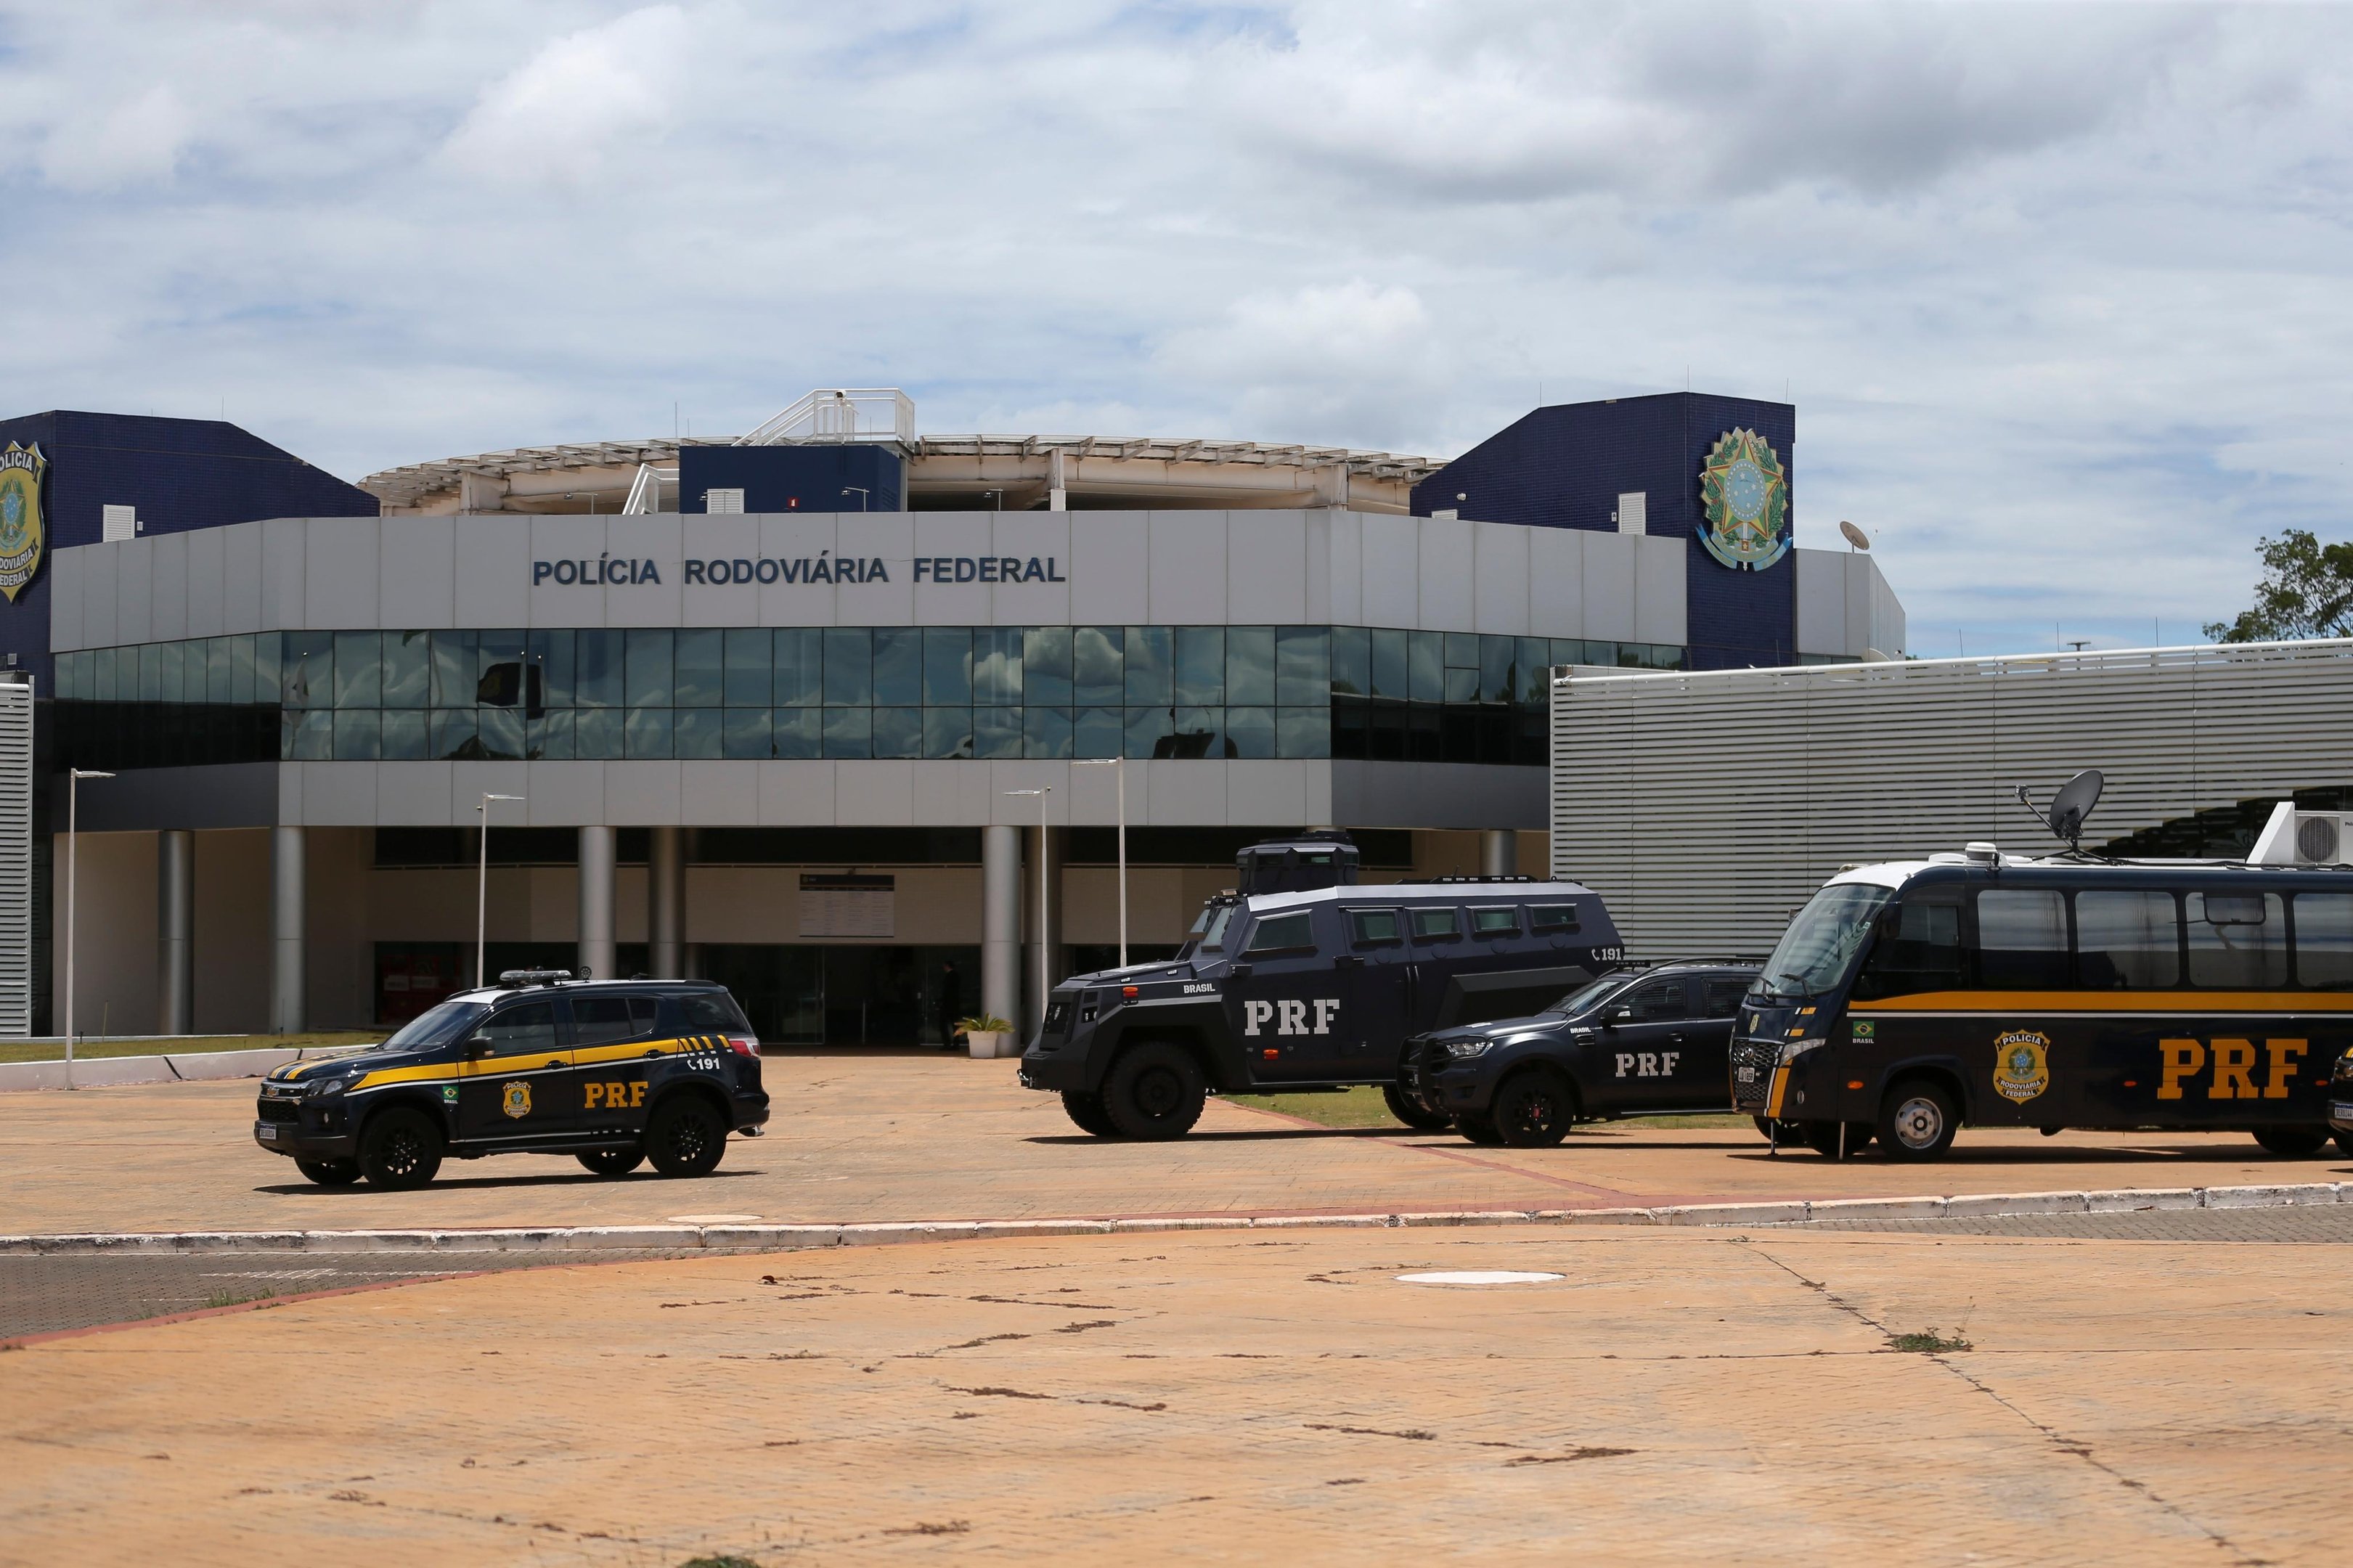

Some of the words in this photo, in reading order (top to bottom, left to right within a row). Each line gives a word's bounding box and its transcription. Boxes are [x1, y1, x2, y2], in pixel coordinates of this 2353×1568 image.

[0, 452, 33, 472] OLÍCIA
[0, 548, 33, 569] DOVIARIA
[533, 552, 661, 586] POLÍCIA
[685, 550, 889, 586] RODOVIÁRIA
[913, 557, 1066, 583] FEDERAL
[0, 571, 28, 586] EDERAL
[1602, 948, 1621, 960] 191
[1183, 983, 1216, 994] BRASIL
[1244, 999, 1340, 1036] PRF
[696, 1058, 720, 1070] 191
[1615, 1052, 1680, 1077] PRF
[2157, 1039, 2308, 1100] PRF
[584, 1081, 648, 1108] PRF
